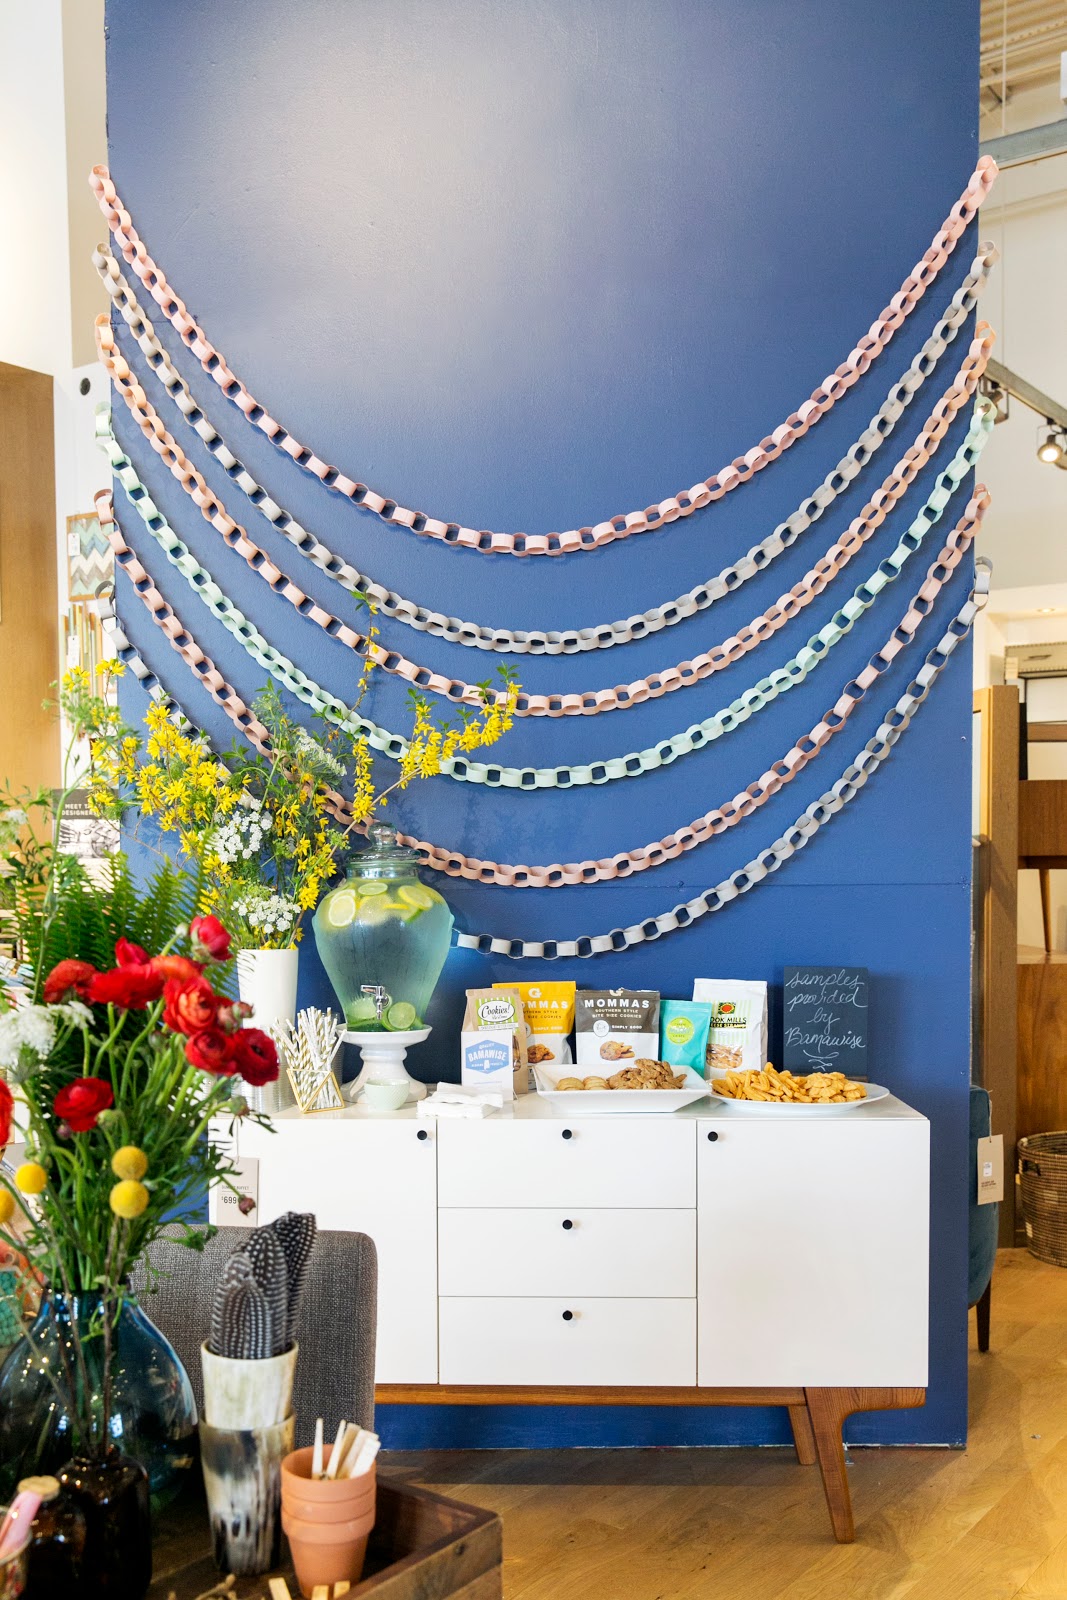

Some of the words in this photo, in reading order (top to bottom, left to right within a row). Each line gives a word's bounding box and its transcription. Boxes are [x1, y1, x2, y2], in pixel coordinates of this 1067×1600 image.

[785, 969, 865, 989] samples
[584, 998, 650, 1009] MOMMAS
[787, 986, 868, 1012] provided
[481, 1004, 511, 1019] Cookies!
[727, 1016, 747, 1024] MILLS
[806, 1006, 841, 1036] by
[785, 1027, 866, 1053] Bamawise
[467, 1049, 508, 1062] BAMAWISE
